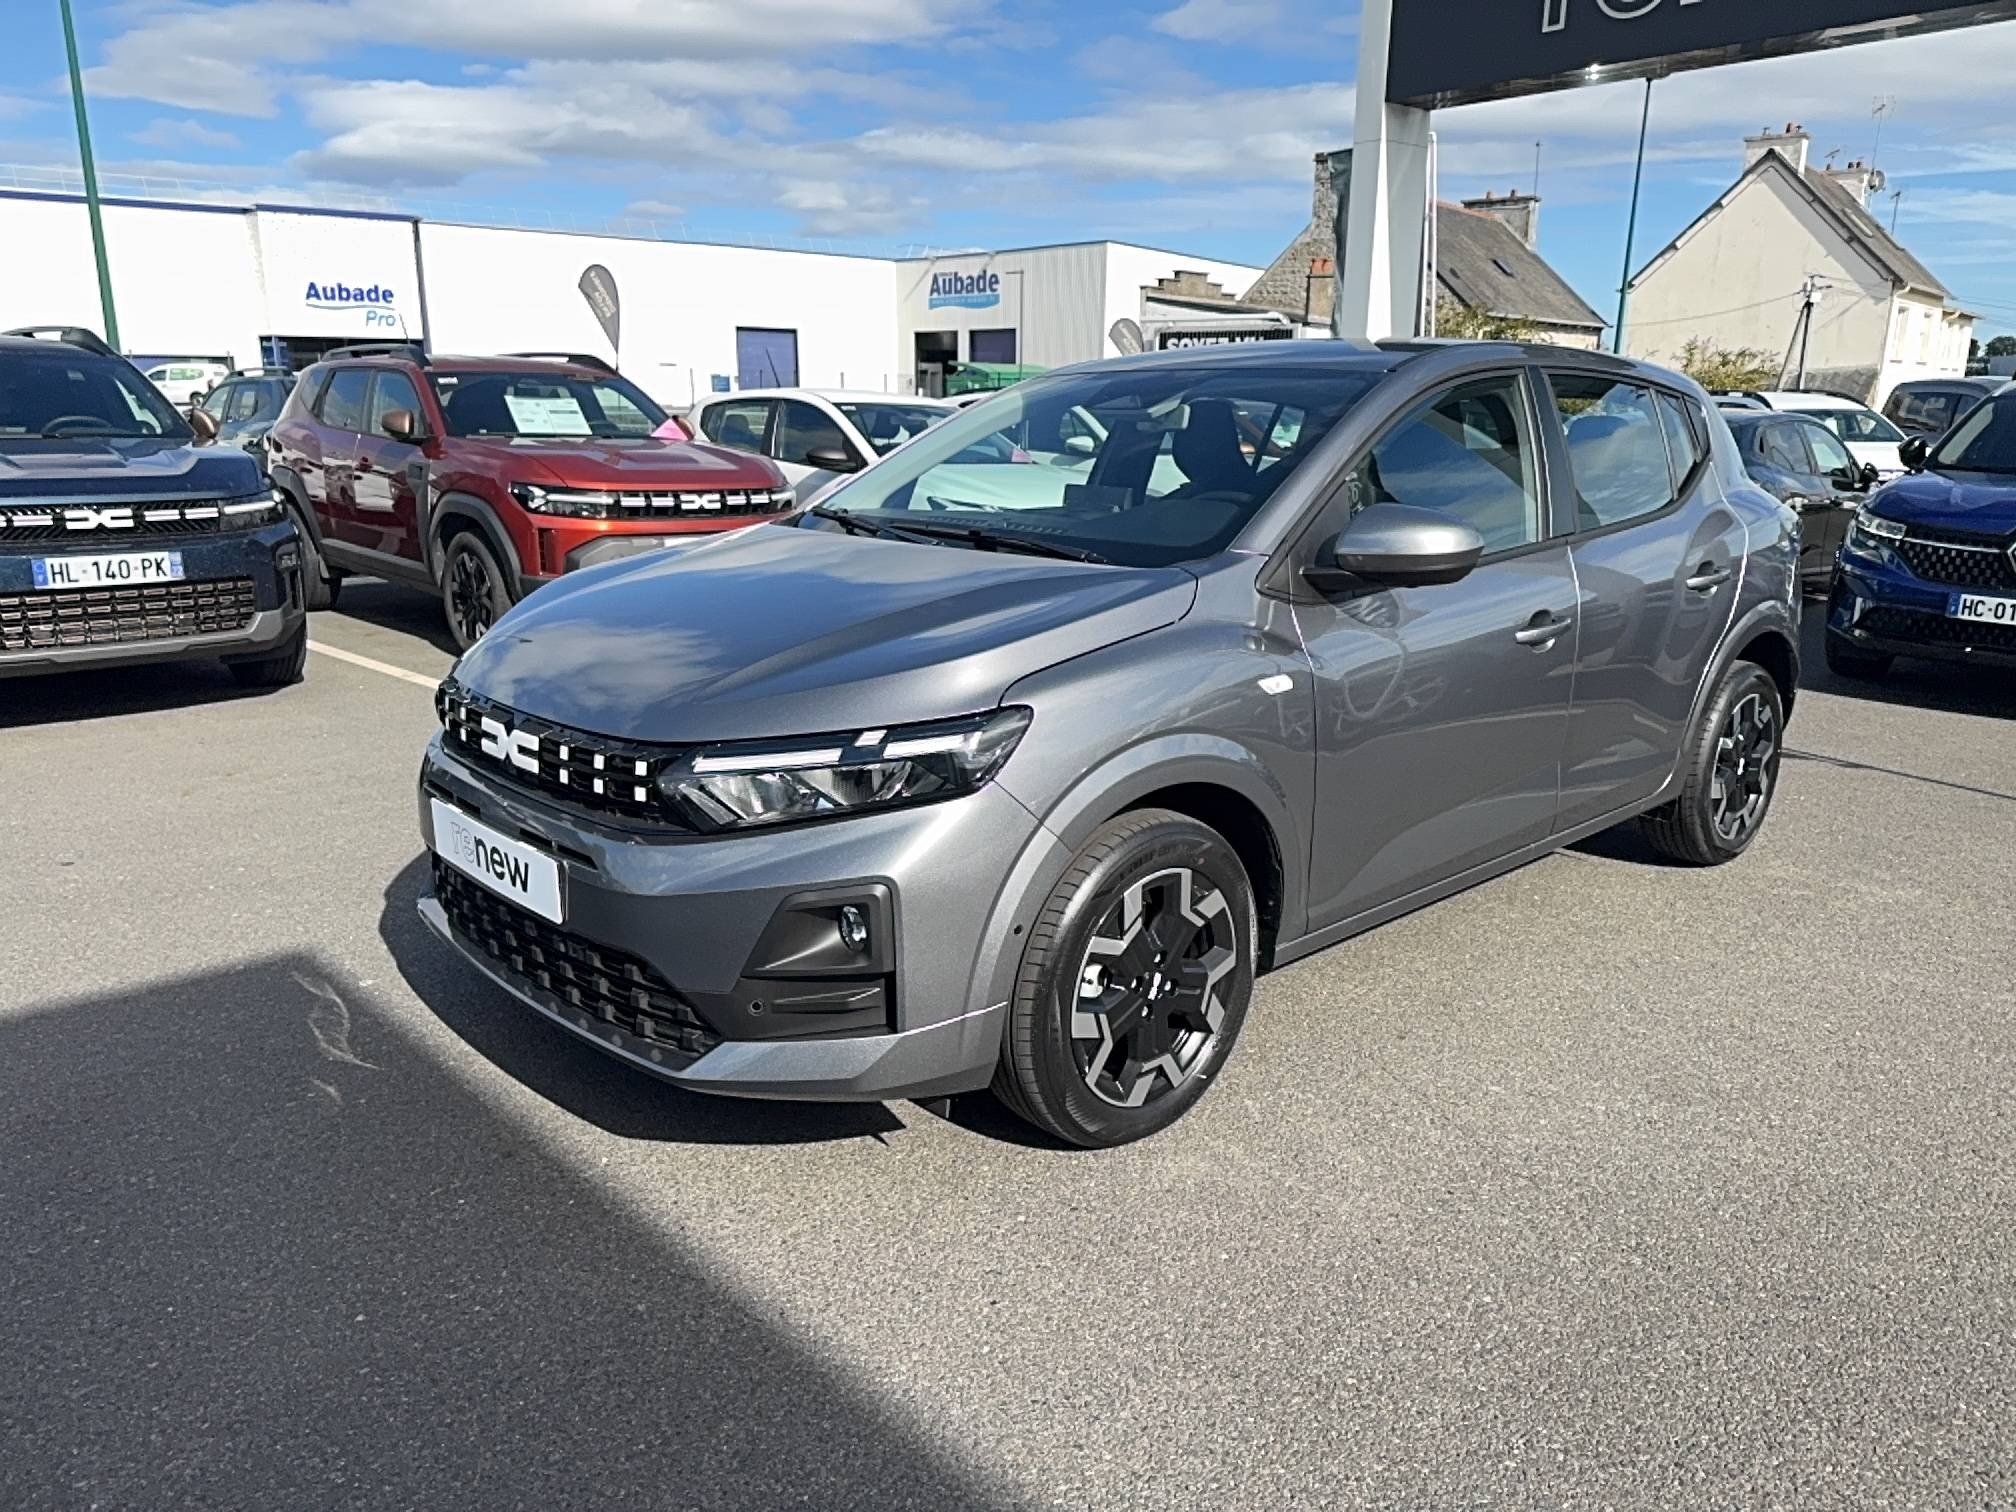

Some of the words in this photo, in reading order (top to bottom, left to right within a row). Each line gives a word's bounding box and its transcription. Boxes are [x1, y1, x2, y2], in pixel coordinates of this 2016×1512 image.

[305, 281, 394, 304] Aubade
[930, 269, 999, 296] Aubade
[366, 310, 396, 327] Pro
[50, 557, 168, 583] HL-140-PK
[450, 821, 529, 893] renew
